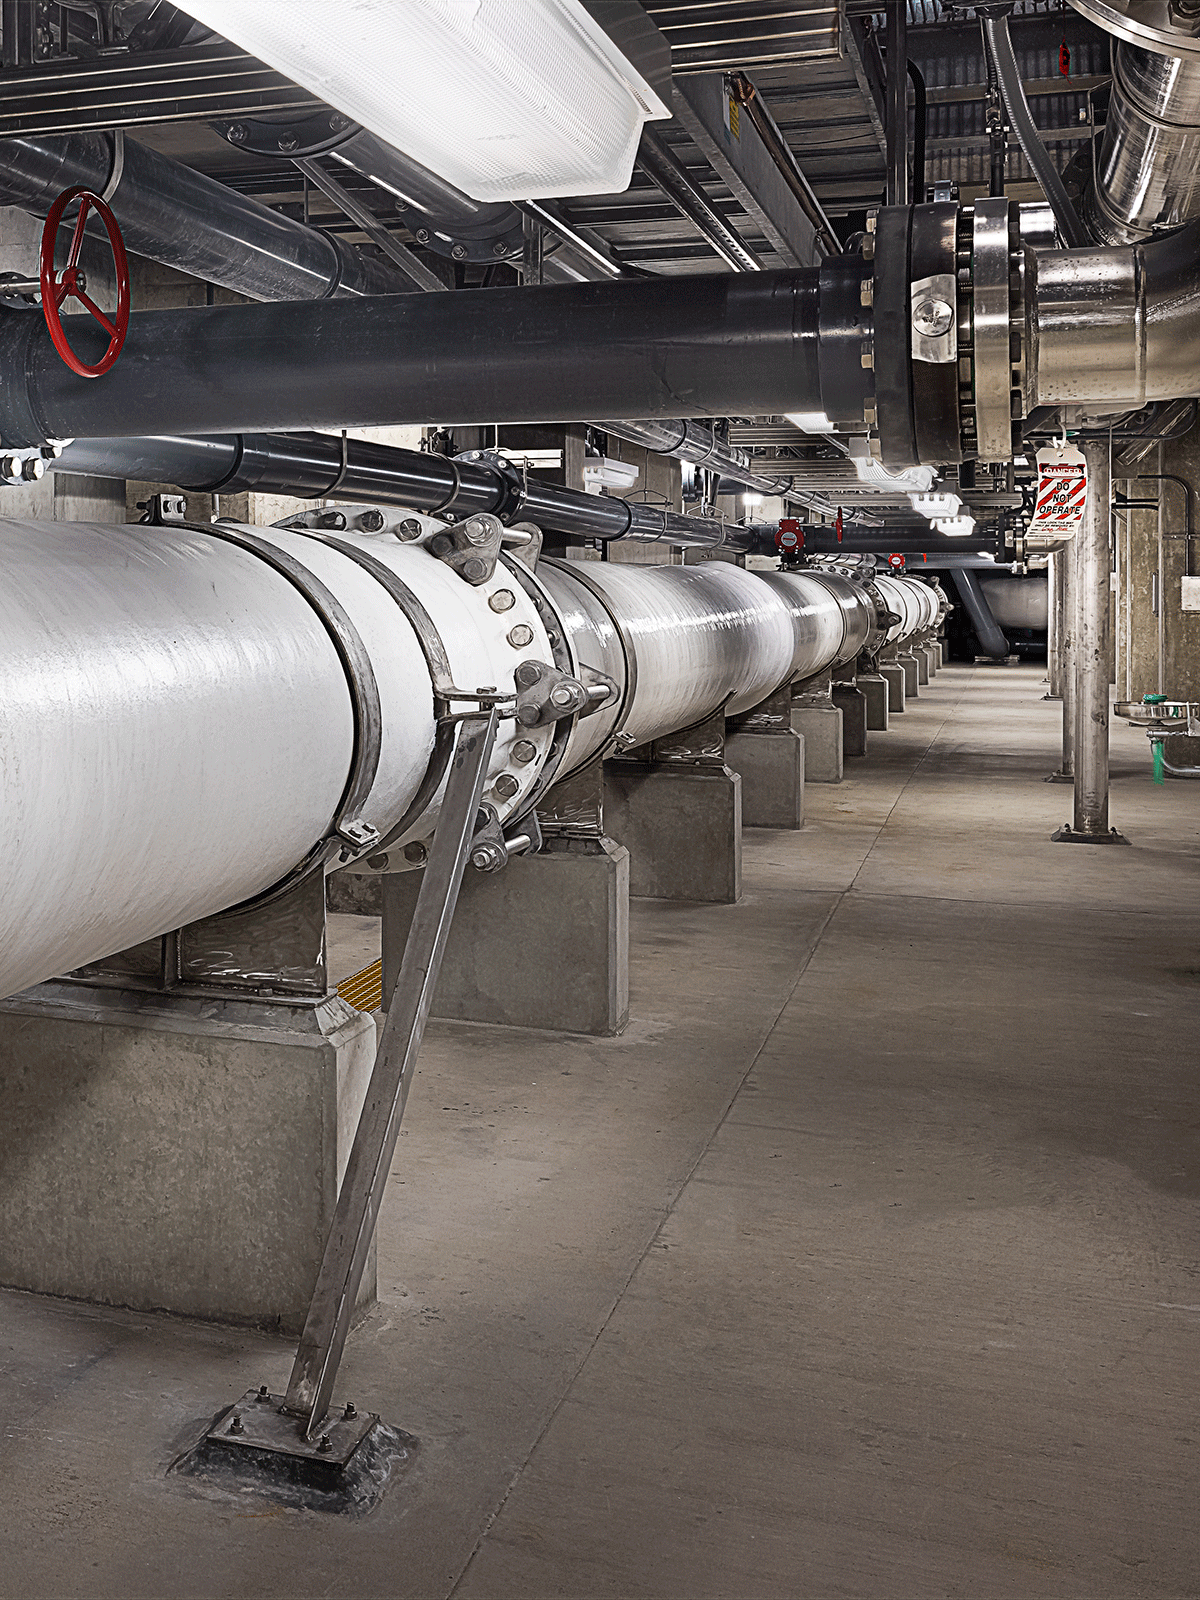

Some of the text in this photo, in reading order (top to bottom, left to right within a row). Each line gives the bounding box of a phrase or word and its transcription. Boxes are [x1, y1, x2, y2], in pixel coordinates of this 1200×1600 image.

[1046, 468, 1080, 476] DANGER
[1056, 482, 1070, 491] DO
[1052, 494, 1072, 502] NOT
[1039, 505, 1081, 514] OPERATE
